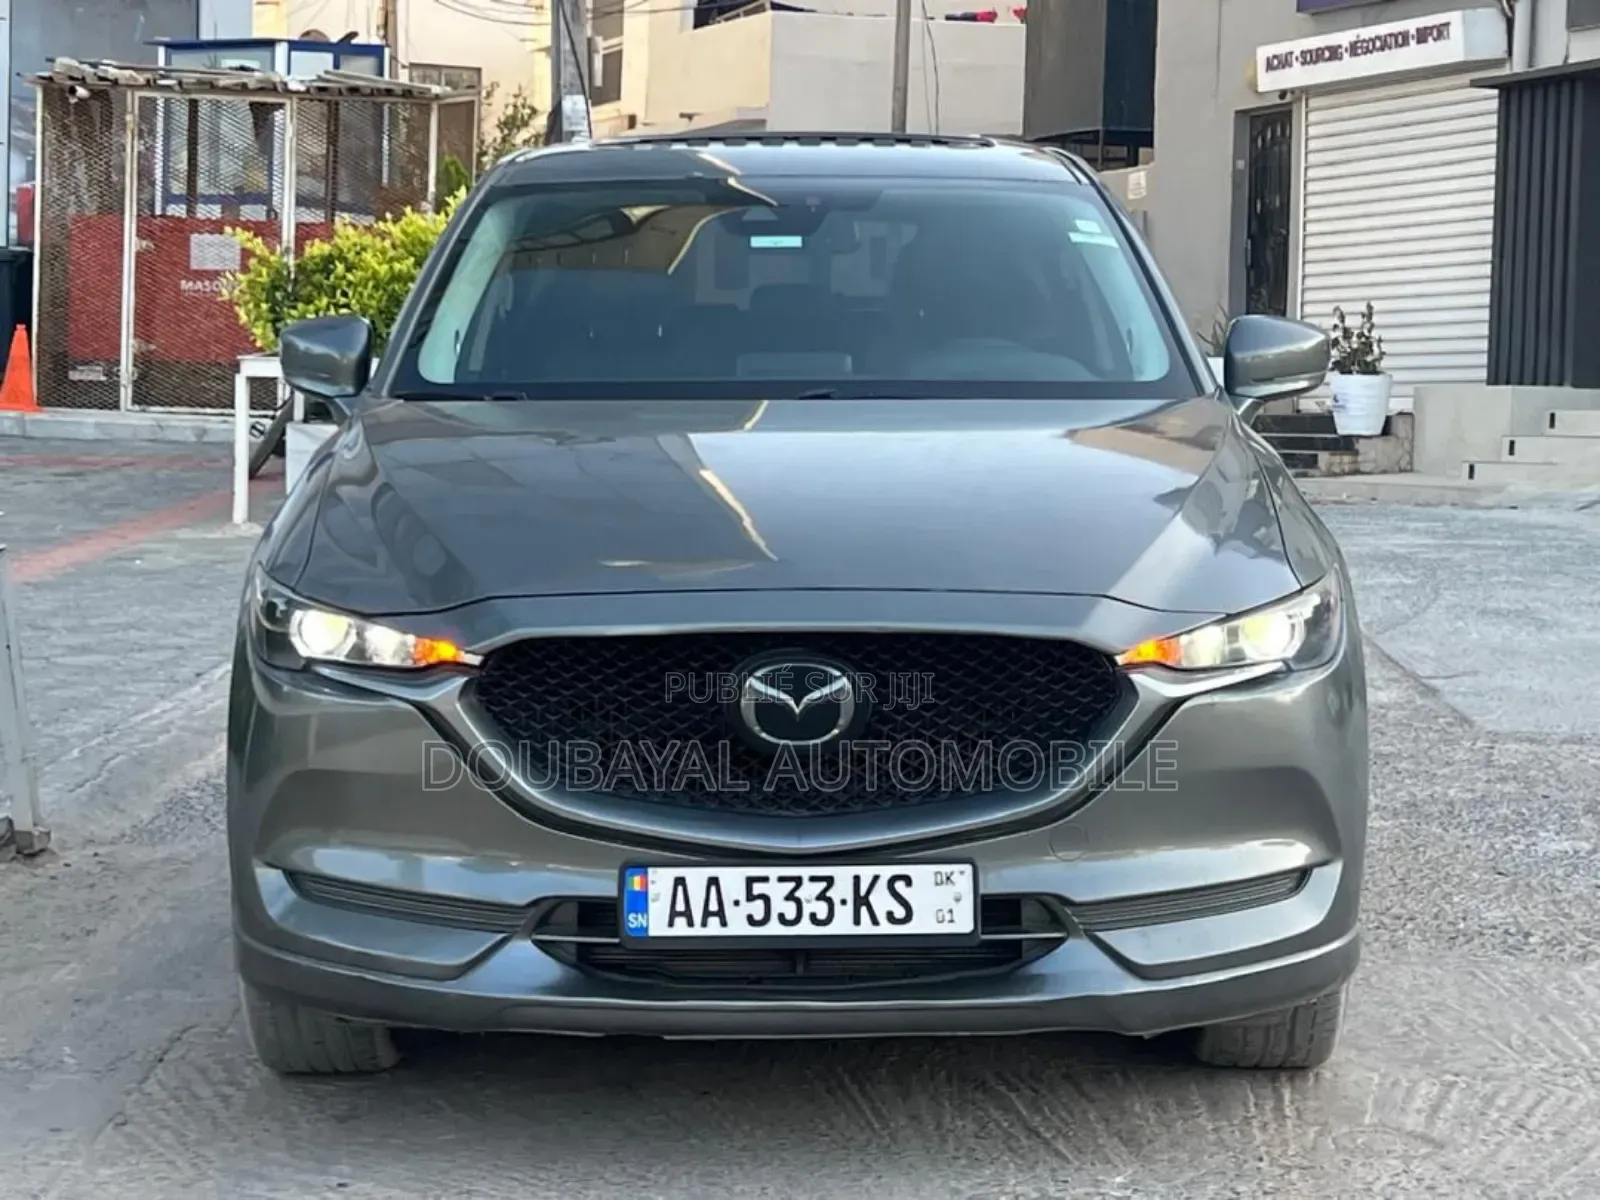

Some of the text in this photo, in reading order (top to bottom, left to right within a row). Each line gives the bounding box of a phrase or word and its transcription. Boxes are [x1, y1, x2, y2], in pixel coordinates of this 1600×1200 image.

[1265, 21, 1451, 73] ACHAT SOURCING NÉGOCIATION IMPORT
[933, 870, 956, 887] DK
[627, 912, 648, 929] SN
